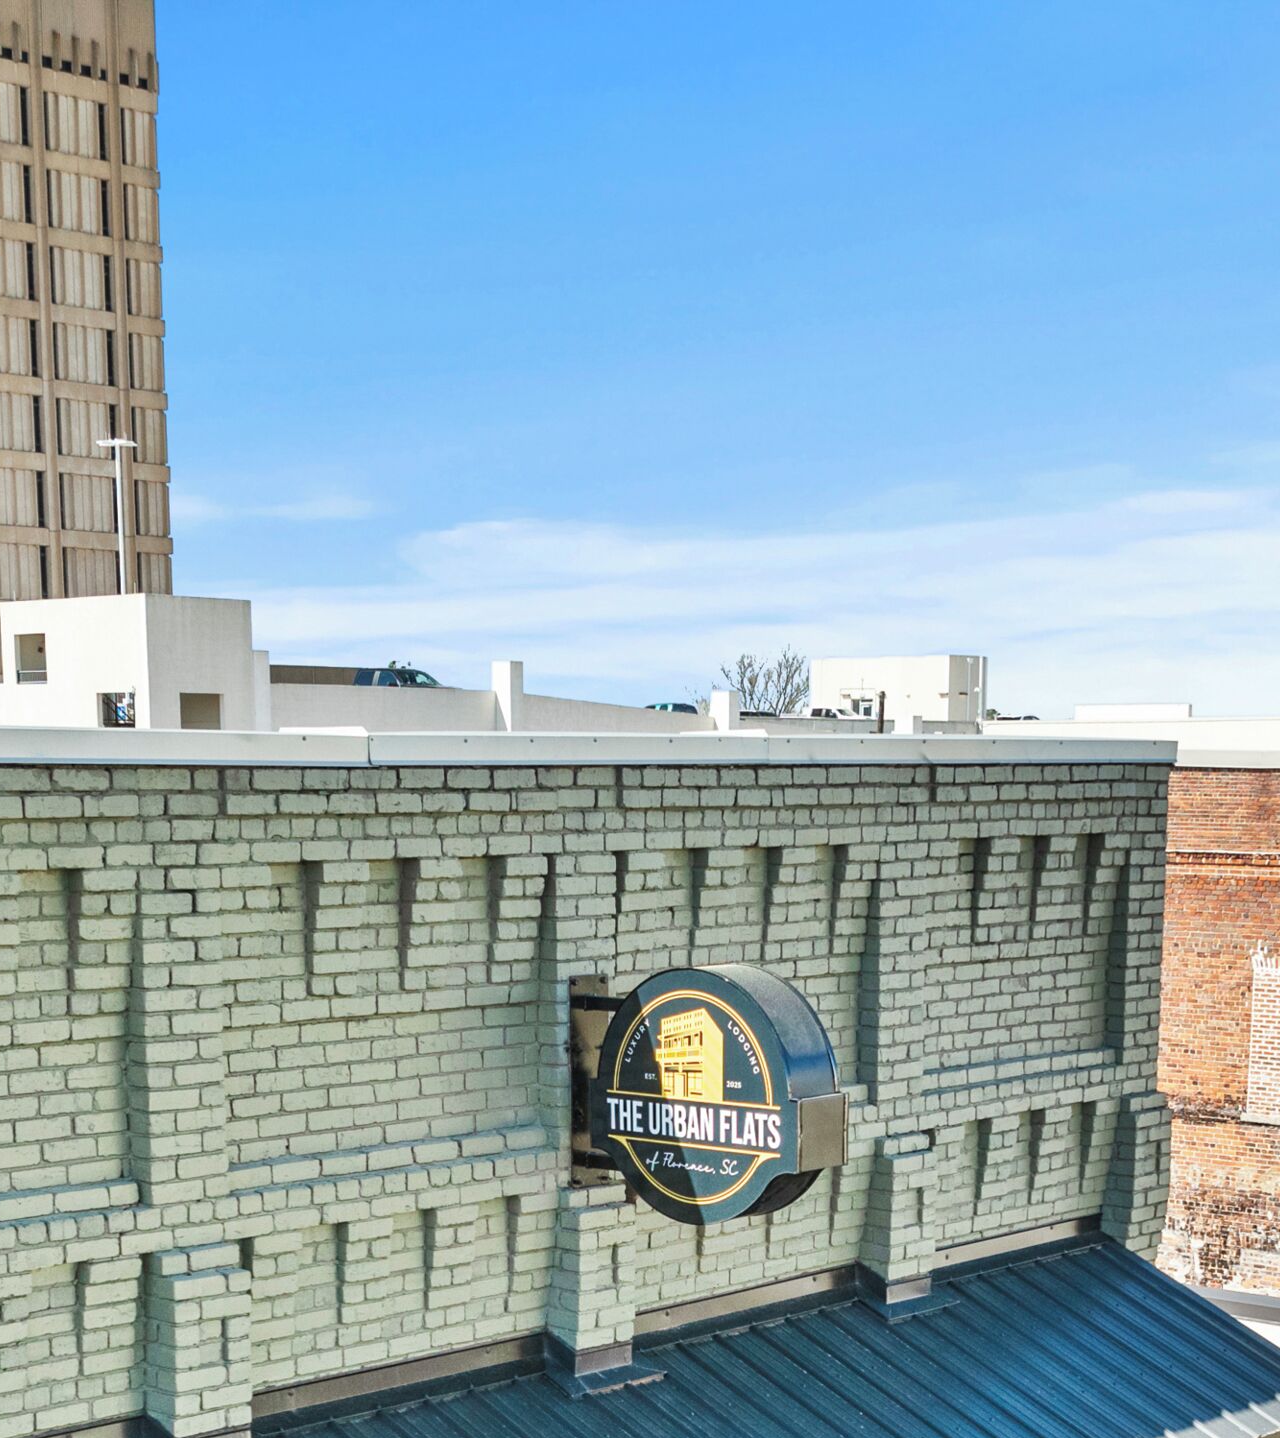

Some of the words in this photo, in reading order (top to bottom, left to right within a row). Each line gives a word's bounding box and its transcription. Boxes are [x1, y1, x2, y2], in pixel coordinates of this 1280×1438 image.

[625, 1018, 650, 1063] LUXURY
[727, 1020, 760, 1074] LODGING
[726, 1080, 742, 1088] 2025
[607, 1097, 644, 1133] THE
[648, 1102, 714, 1142] URBAN
[719, 1109, 781, 1149] FLATS
[645, 1151, 659, 1172] of
[720, 1158, 740, 1176] SC
